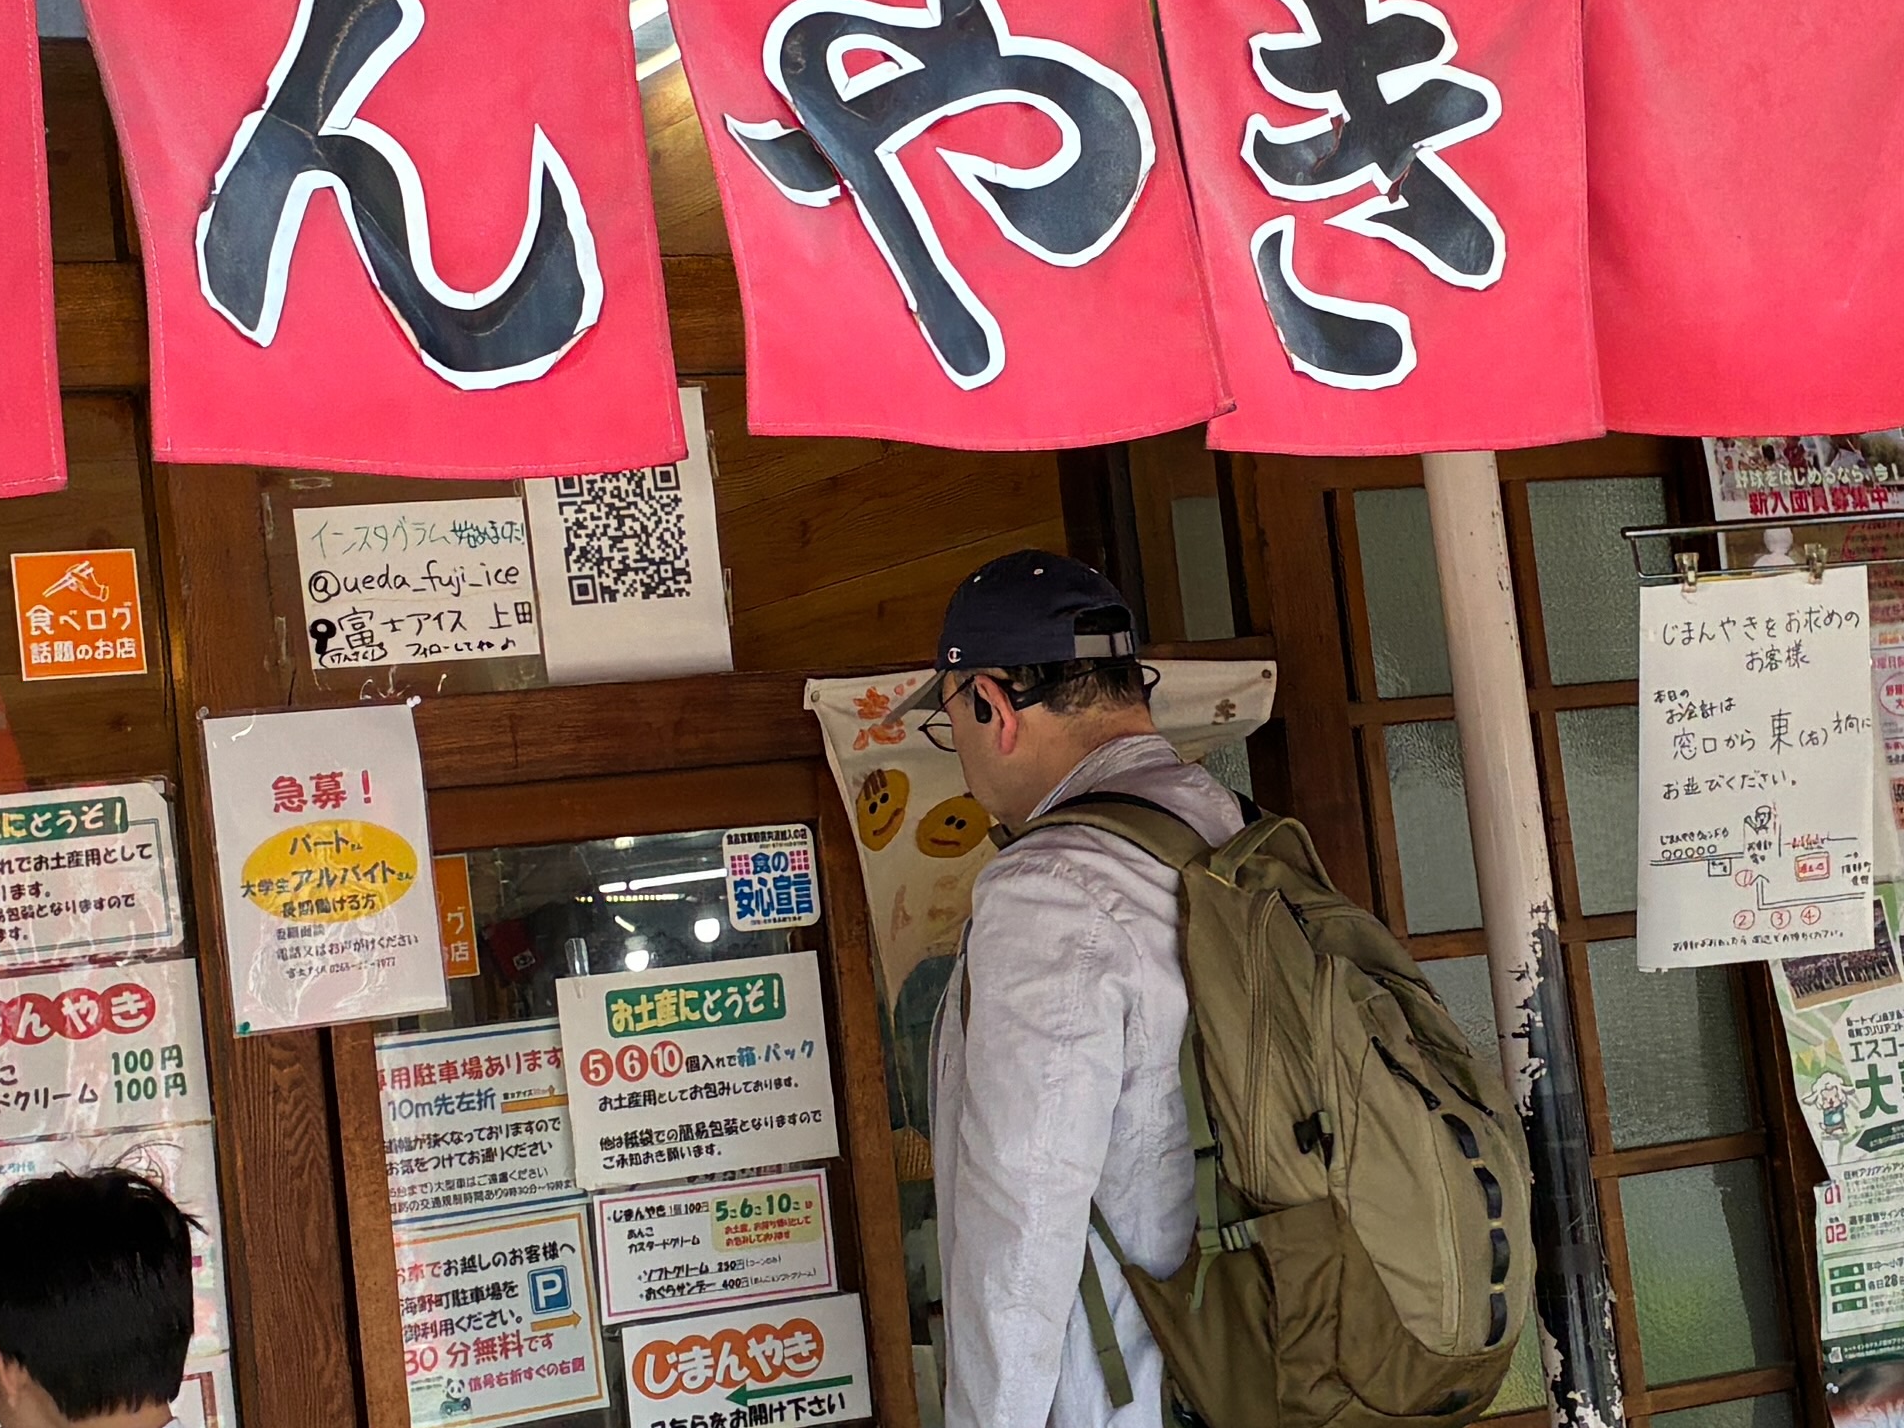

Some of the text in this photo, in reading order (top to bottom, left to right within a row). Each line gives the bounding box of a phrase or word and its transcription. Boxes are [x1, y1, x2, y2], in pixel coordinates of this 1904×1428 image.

[308, 559, 520, 604] @ueda_fuji_ice
[25, 601, 133, 636] 食べログ
[489, 600, 533, 630] 上田
[1662, 605, 1860, 646] じまんやきをお求めの
[29, 636, 137, 665] 話題のお店
[751, 851, 789, 876] 食の
[733, 873, 814, 920] 安心宣言
[443, 940, 470, 963] 店
[111, 1045, 184, 1074] 100円
[114, 1072, 187, 1104] 100円
[388, 1087, 496, 1121] 10m先左折
[602, 1143, 722, 1169] ご承知おき願います。
[534, 1272, 563, 1309] P
[644, 1330, 819, 1394] じまんやき
